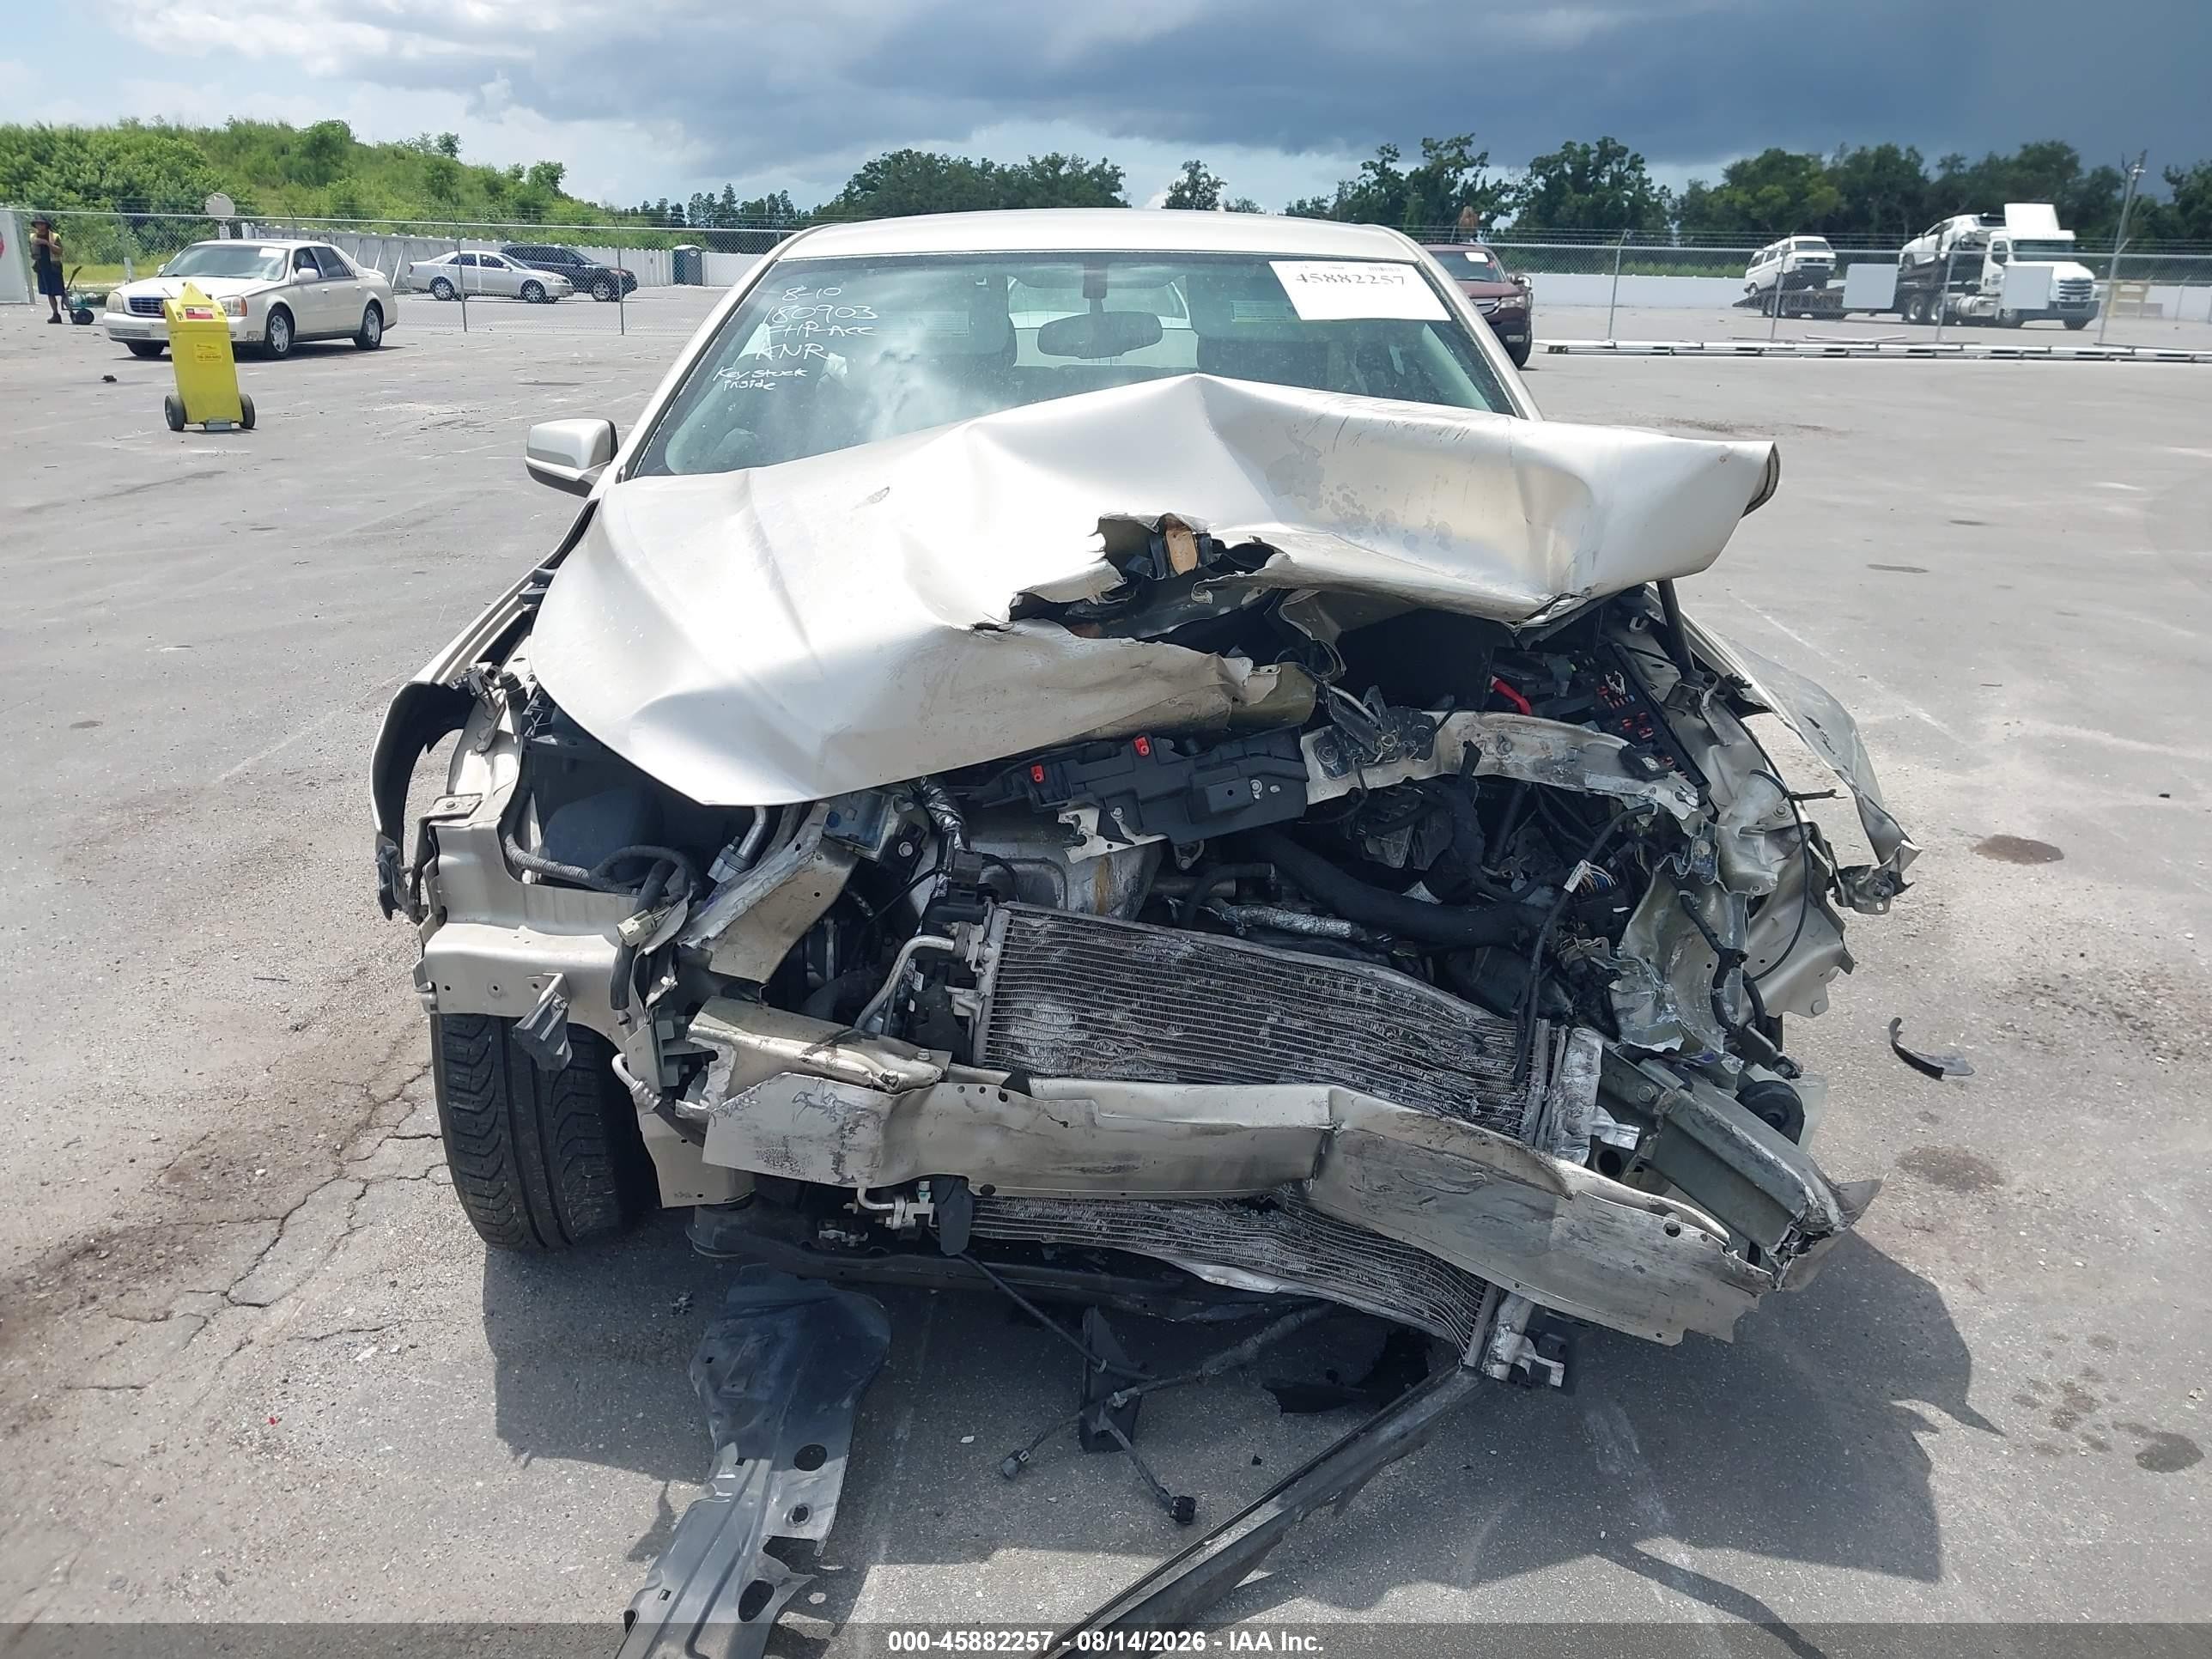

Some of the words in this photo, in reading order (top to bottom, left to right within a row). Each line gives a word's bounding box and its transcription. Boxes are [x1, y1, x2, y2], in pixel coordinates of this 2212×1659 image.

[1296, 272, 1405, 286] 45882257
[781, 285, 842, 301] 8-10
[762, 304, 879, 325] 180903
[712, 366, 750, 381] Key
